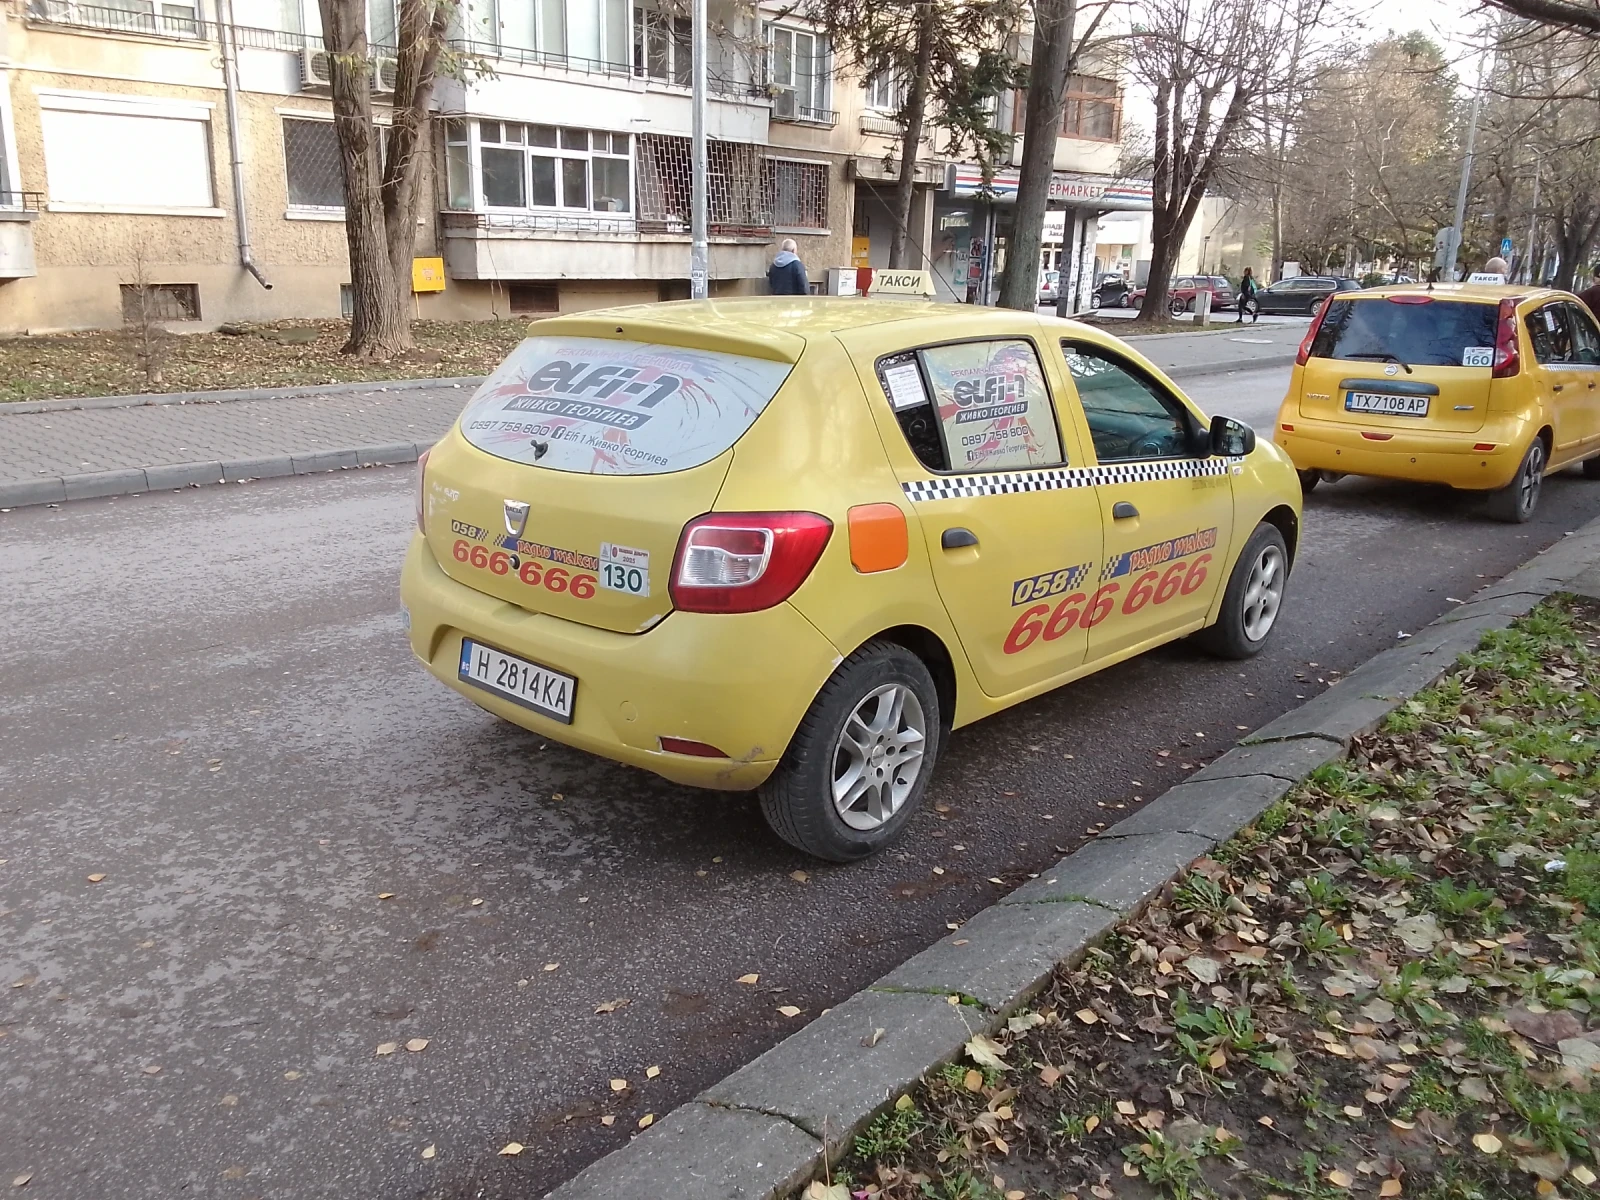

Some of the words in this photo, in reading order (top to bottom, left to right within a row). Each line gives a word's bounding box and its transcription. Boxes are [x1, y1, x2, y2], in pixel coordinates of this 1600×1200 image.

[1049, 183, 1102, 198] ЕРМАРКЕТ
[879, 275, 921, 287] ТАКСИ
[1466, 355, 1490, 365] 160
[511, 398, 561, 411] ЖИВКО
[560, 402, 640, 427] ГЕОРГИЕВ
[960, 410, 988, 421] ЖИВКО
[989, 403, 1025, 416] ГЕОРГИЕВ
[500, 421, 523, 432] 758
[523, 423, 550, 436] 800
[961, 433, 987, 446] 0897
[989, 429, 1008, 440] 758
[1009, 426, 1029, 437] 800
[586, 435, 620, 452] Живко
[620, 444, 669, 466] Георгиев
[505, 505, 523, 514] DACIA
[452, 521, 477, 538] 058
[603, 563, 643, 593] 130
[1014, 570, 1070, 605] 058
